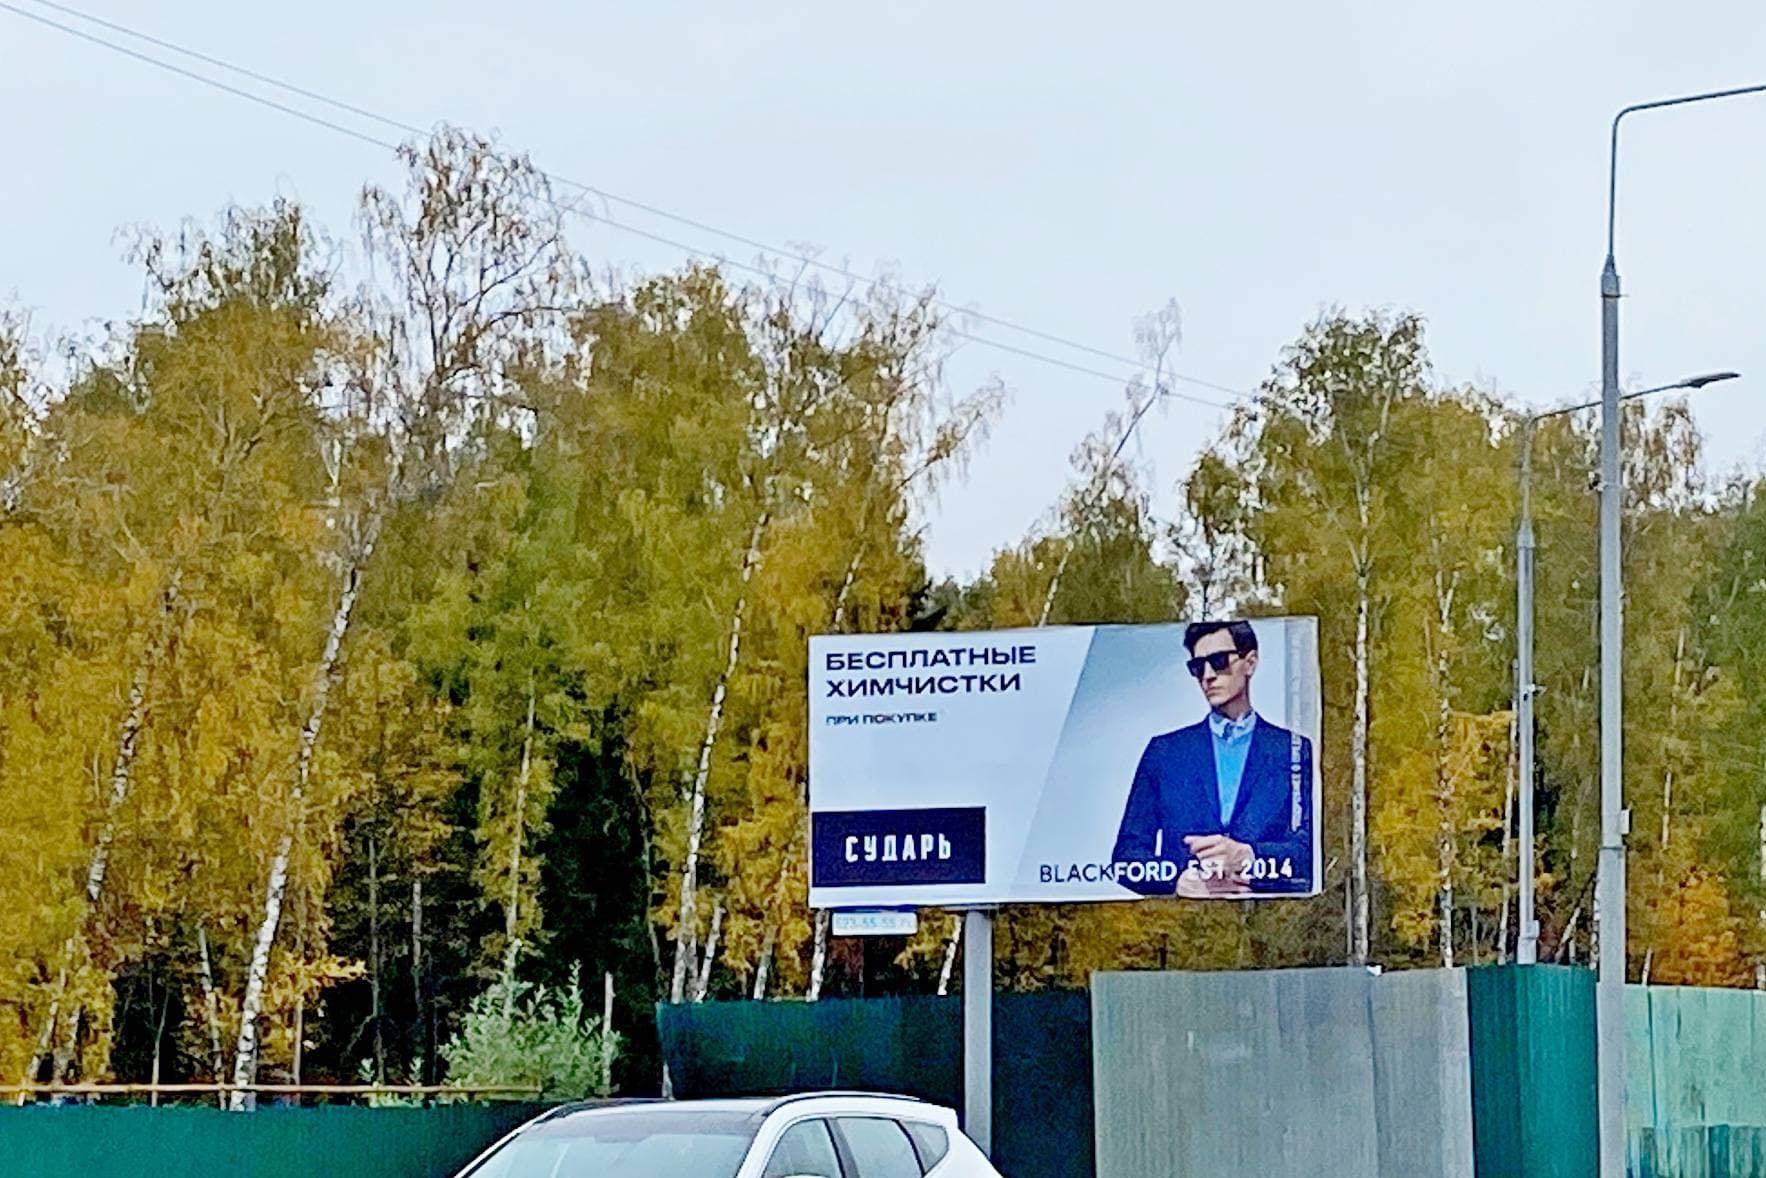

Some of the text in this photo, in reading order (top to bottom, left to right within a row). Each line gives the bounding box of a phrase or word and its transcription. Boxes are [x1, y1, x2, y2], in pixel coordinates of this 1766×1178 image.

[825, 645, 1037, 671] БЕСПЛАТНЫЕ
[825, 673, 1021, 698] ХИМЧИСТКИ
[826, 712, 938, 726] ПРИ ПОКУПКЕ
[845, 833, 951, 863] СУДАРЬ
[1040, 860, 1178, 883] BLACKFORD
[1239, 857, 1293, 880] 2014
